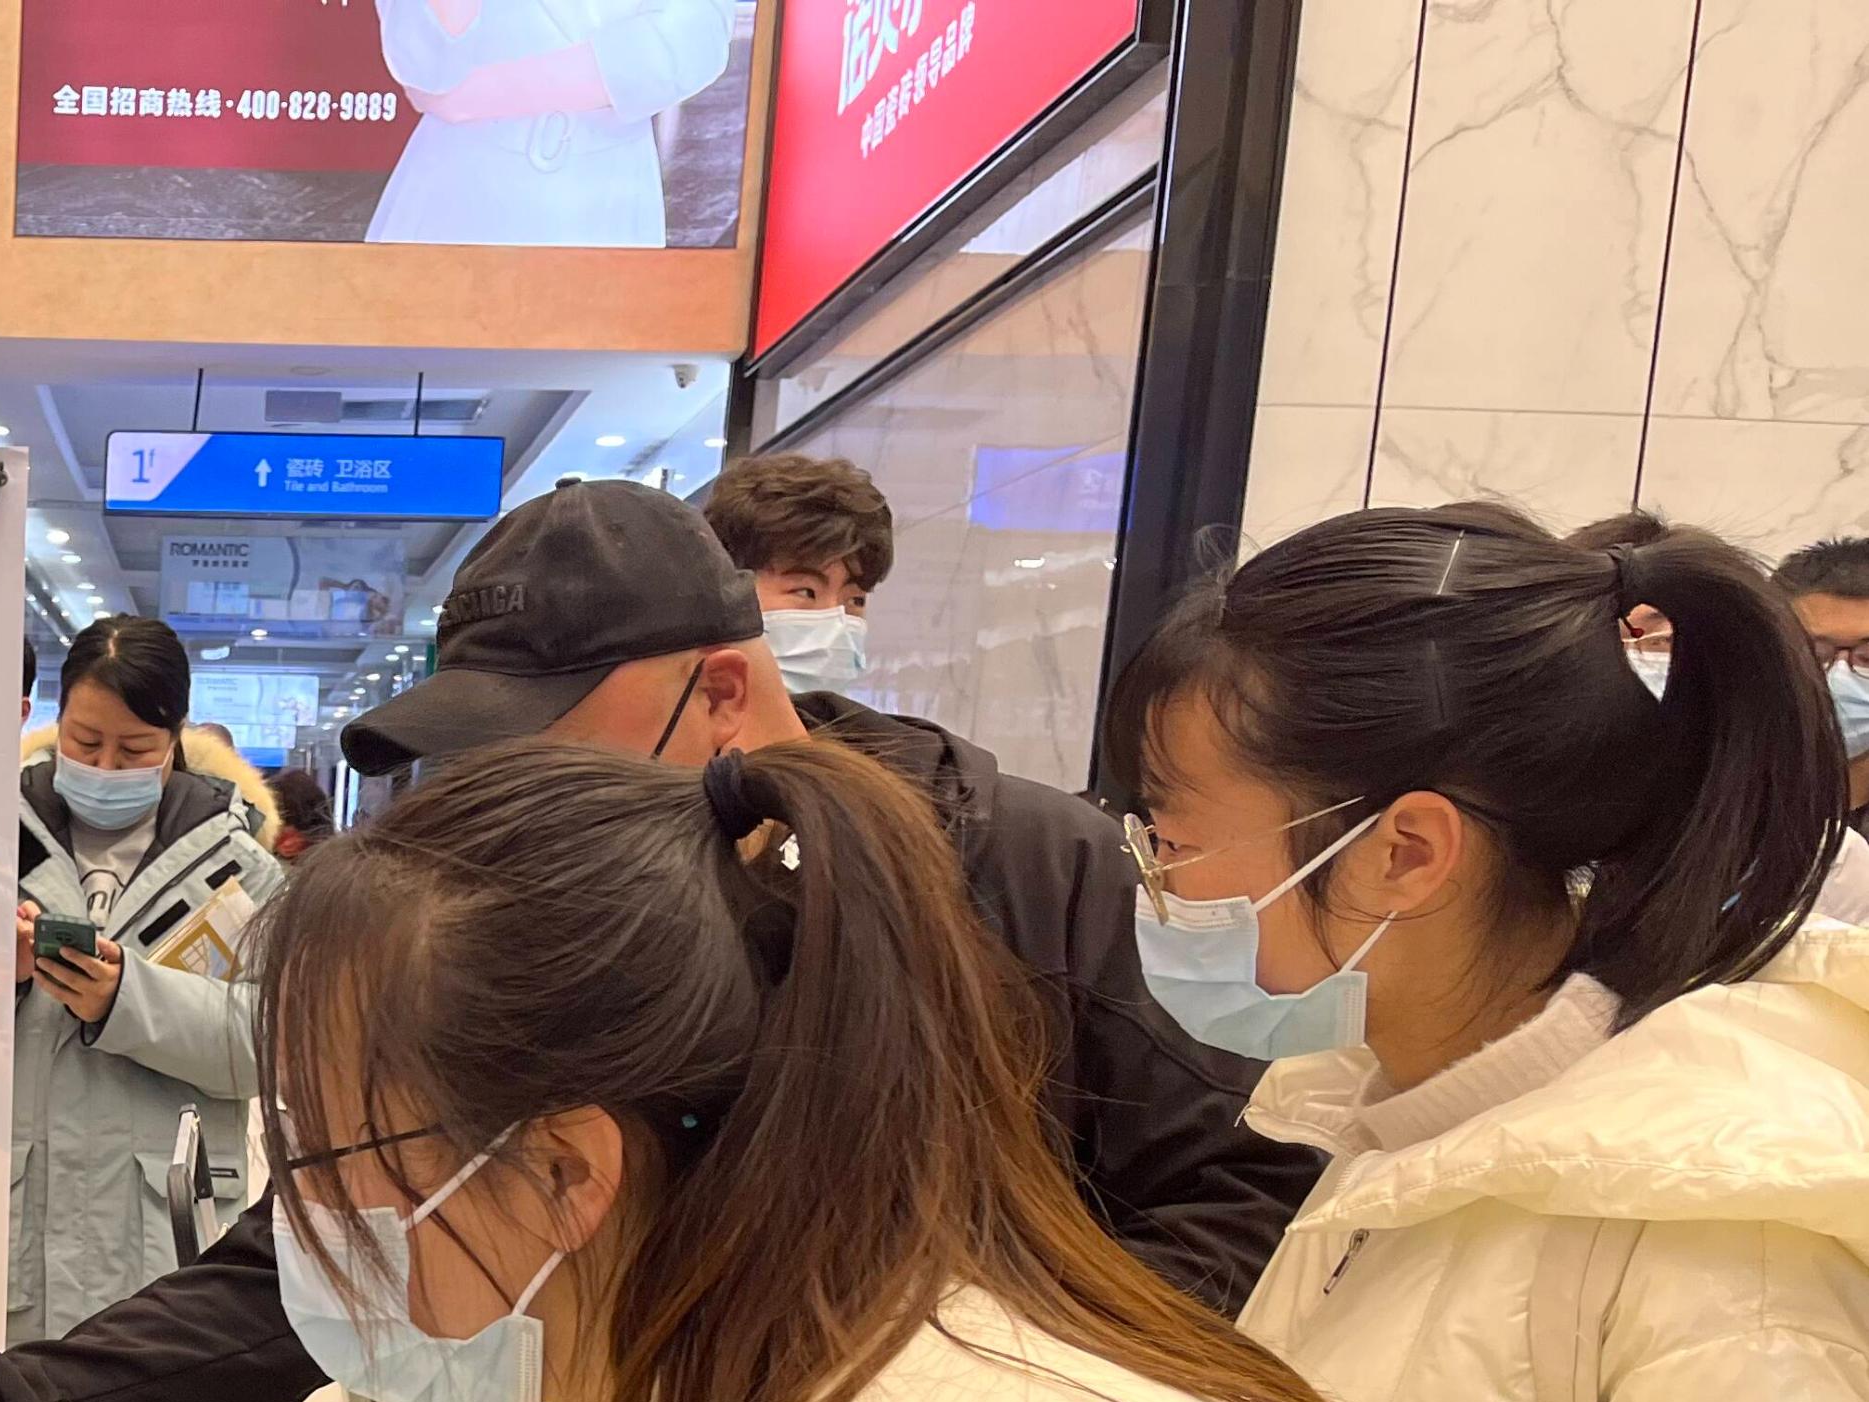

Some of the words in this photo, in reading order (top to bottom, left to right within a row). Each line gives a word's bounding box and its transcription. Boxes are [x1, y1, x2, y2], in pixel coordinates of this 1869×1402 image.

[286, 458, 325, 479] 瓷砖
[334, 458, 393, 480] 卫浴区
[284, 480, 306, 492] Tile
[307, 480, 329, 493] and
[331, 480, 389, 494] Bathroom
[169, 542, 250, 557] ROMANTIC
